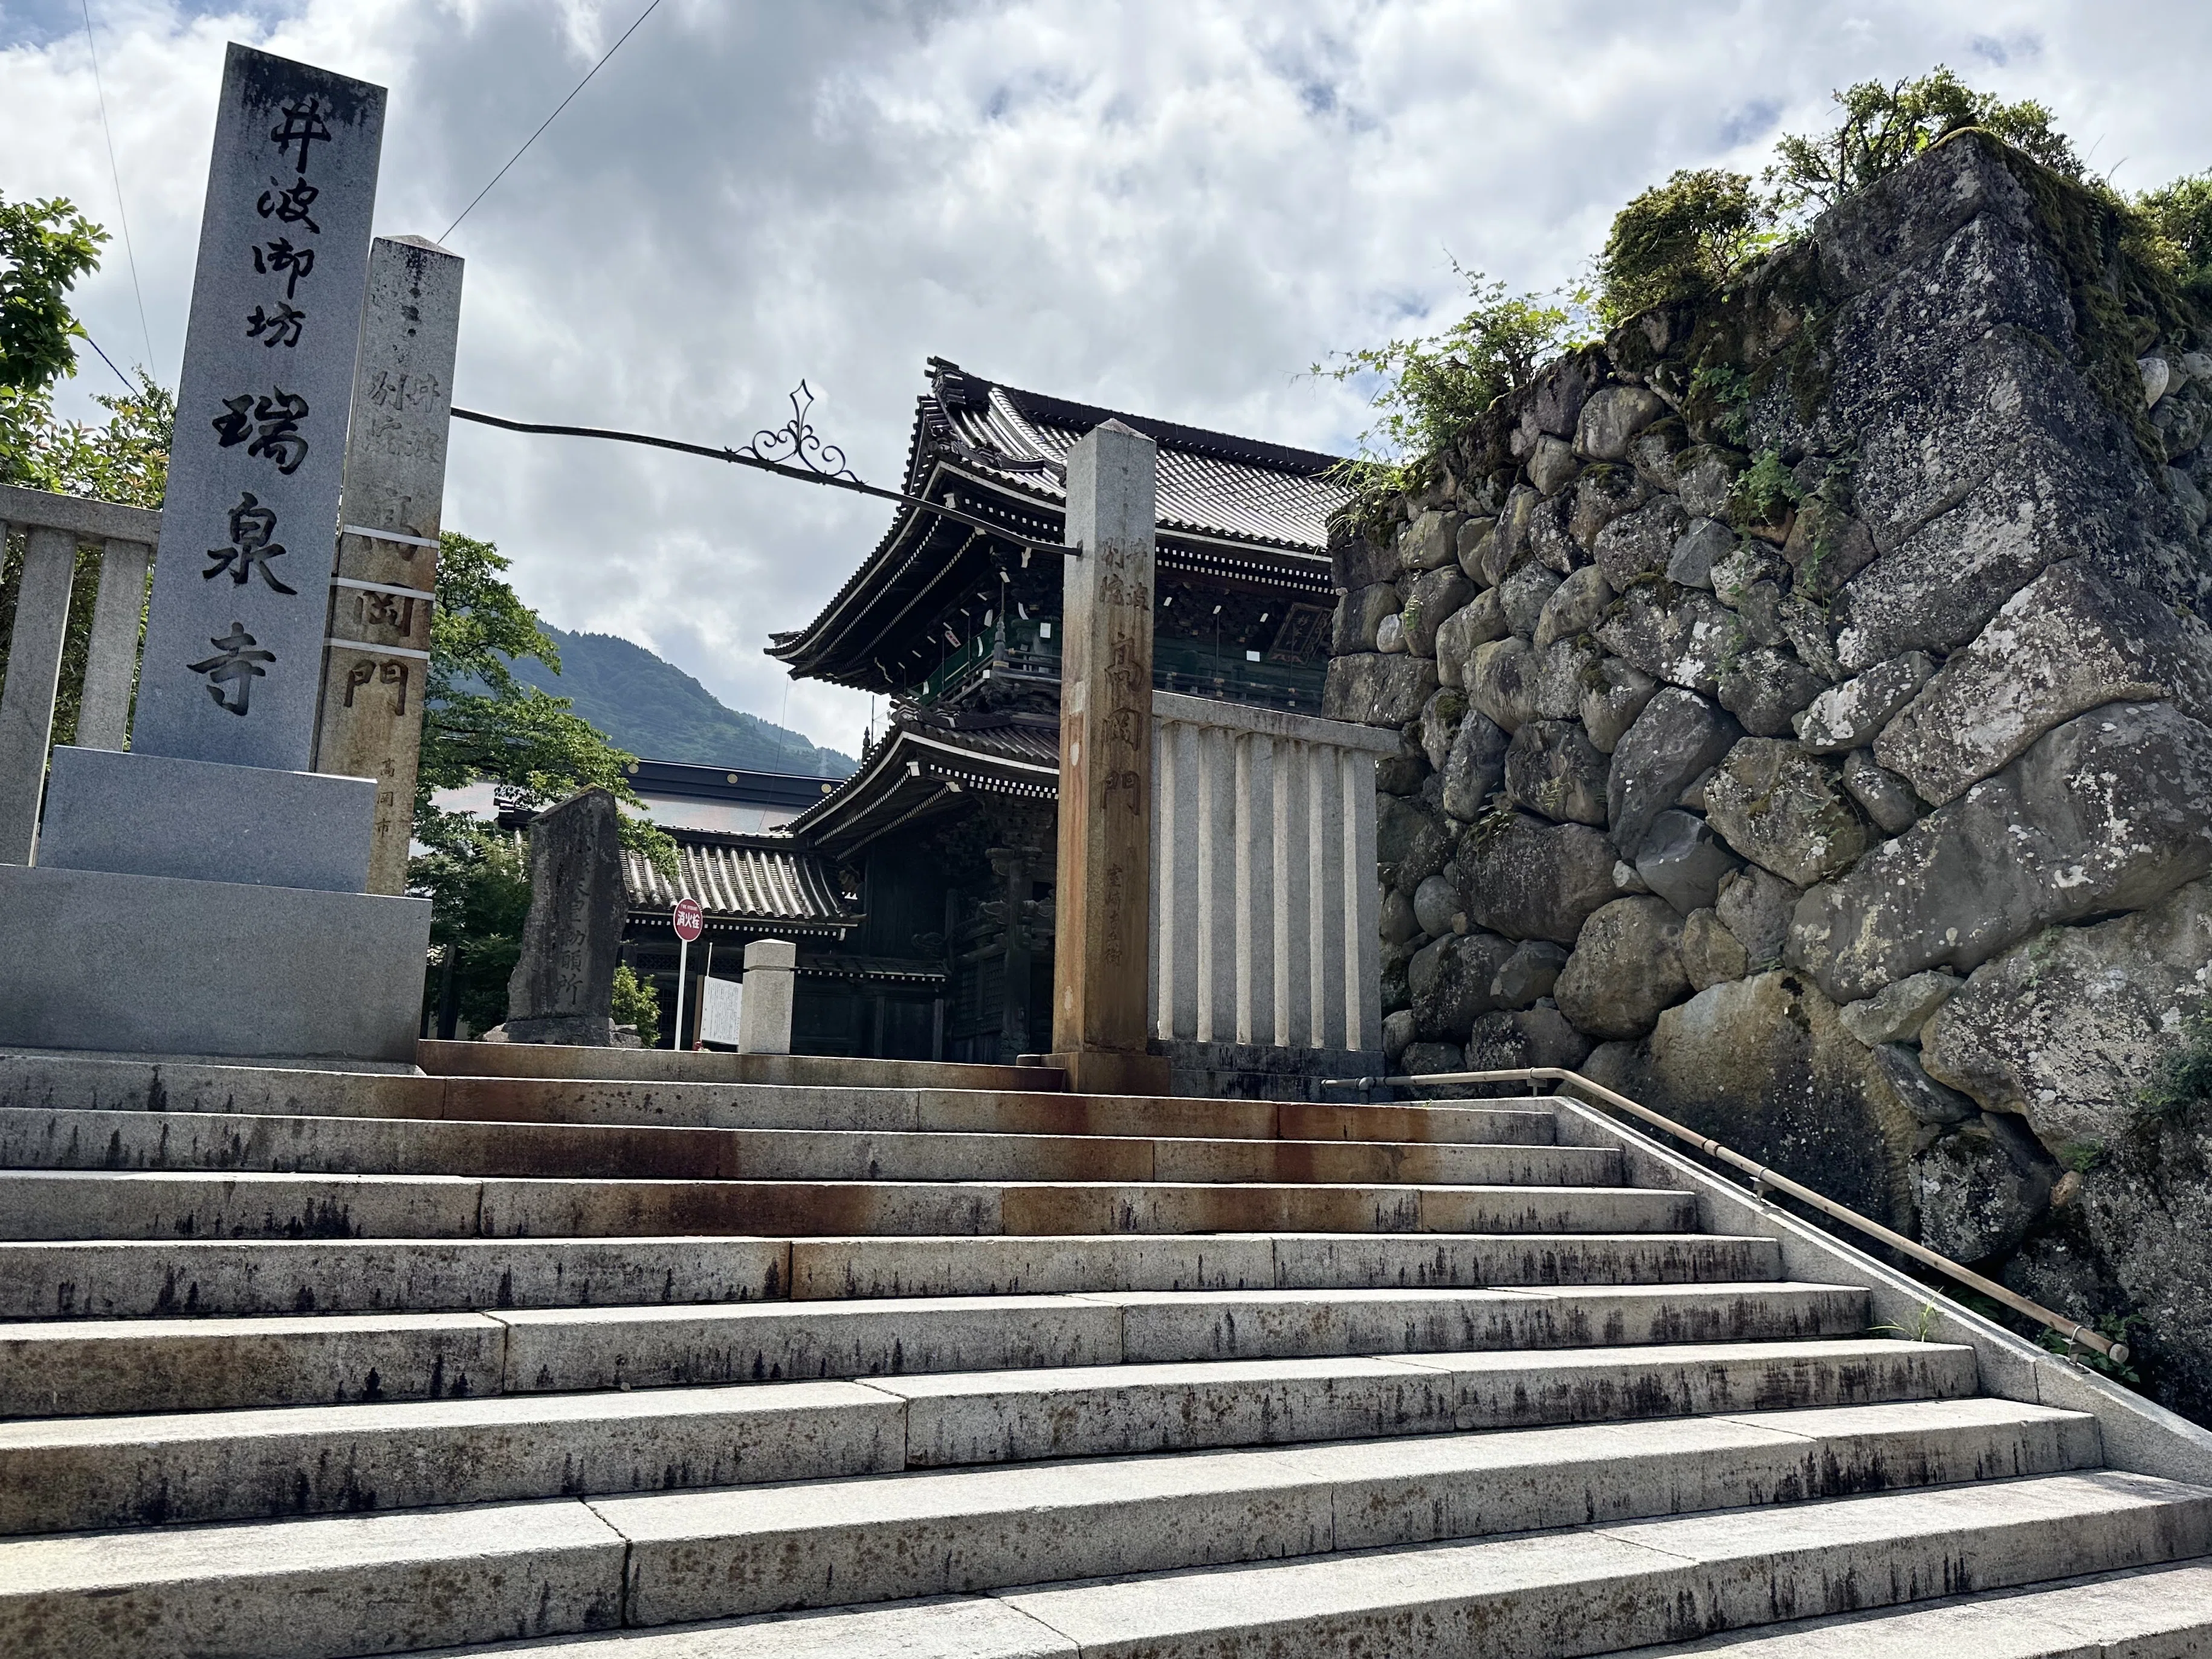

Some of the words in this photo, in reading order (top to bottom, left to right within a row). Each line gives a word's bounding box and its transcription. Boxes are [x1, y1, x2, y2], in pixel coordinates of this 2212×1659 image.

[186, 98, 332, 716] 井波御坊瑞泉寺
[375, 757, 396, 839] 高岡市
[677, 910, 700, 929] 消火栓
